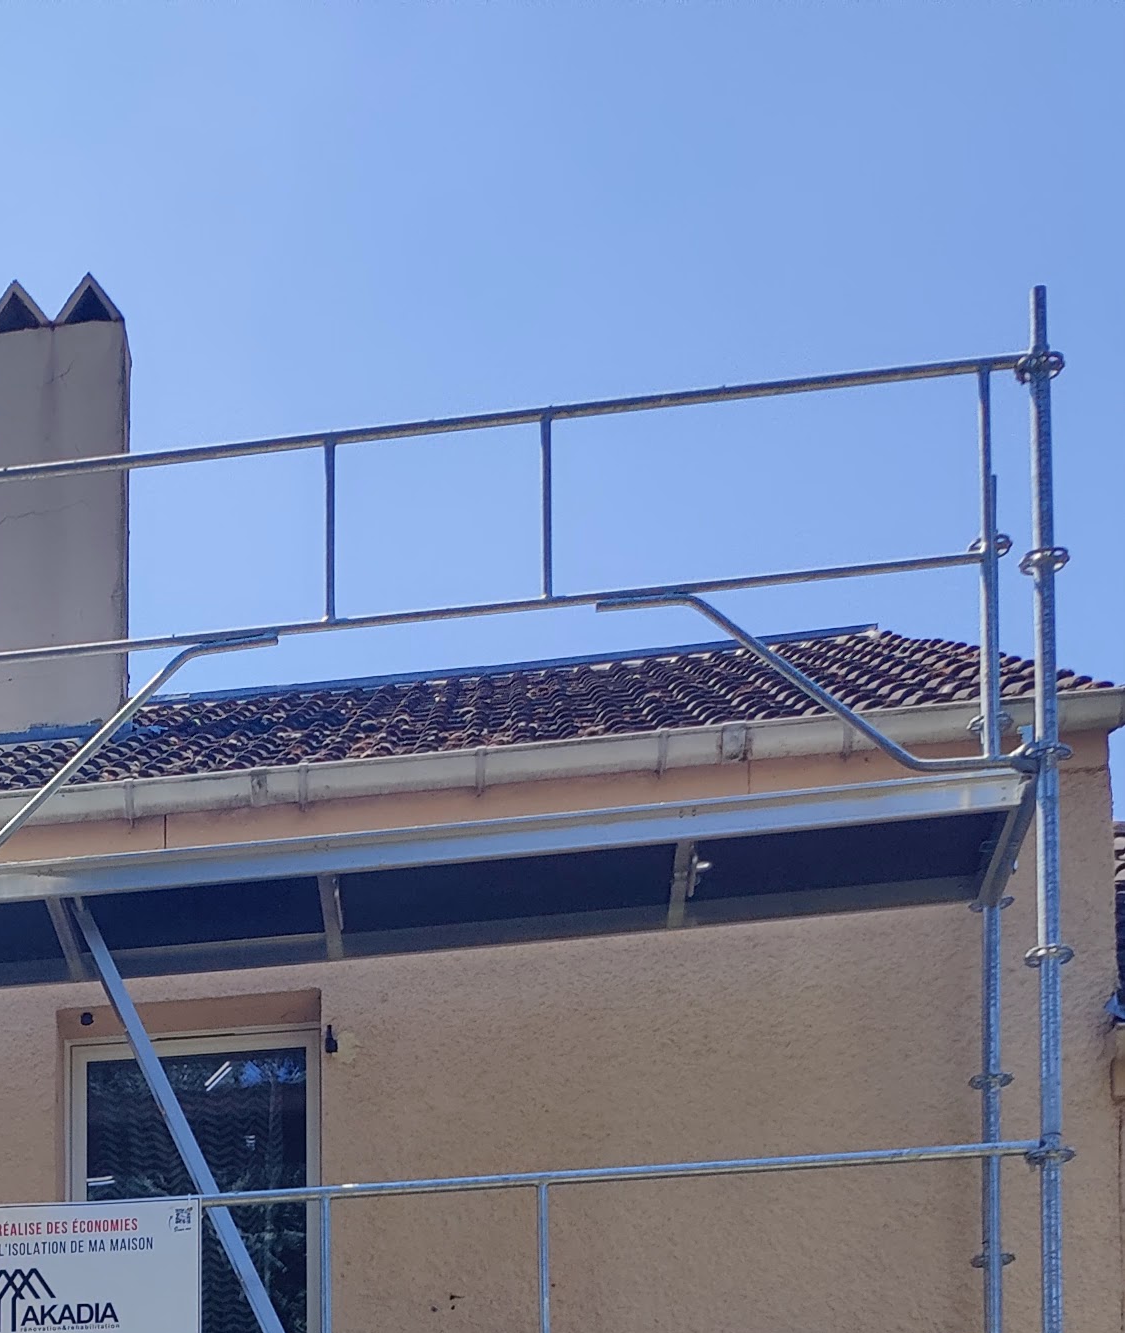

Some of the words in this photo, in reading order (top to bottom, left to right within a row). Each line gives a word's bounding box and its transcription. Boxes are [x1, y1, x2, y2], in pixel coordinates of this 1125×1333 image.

[46, 1221, 68, 1235] DES
[72, 1218, 138, 1234] ÉCONOMIES
[70, 1240, 85, 1254] DE
[88, 1239, 106, 1253] MA
[110, 1237, 154, 1251] MAISON
[20, 1302, 119, 1326] AKADIA
